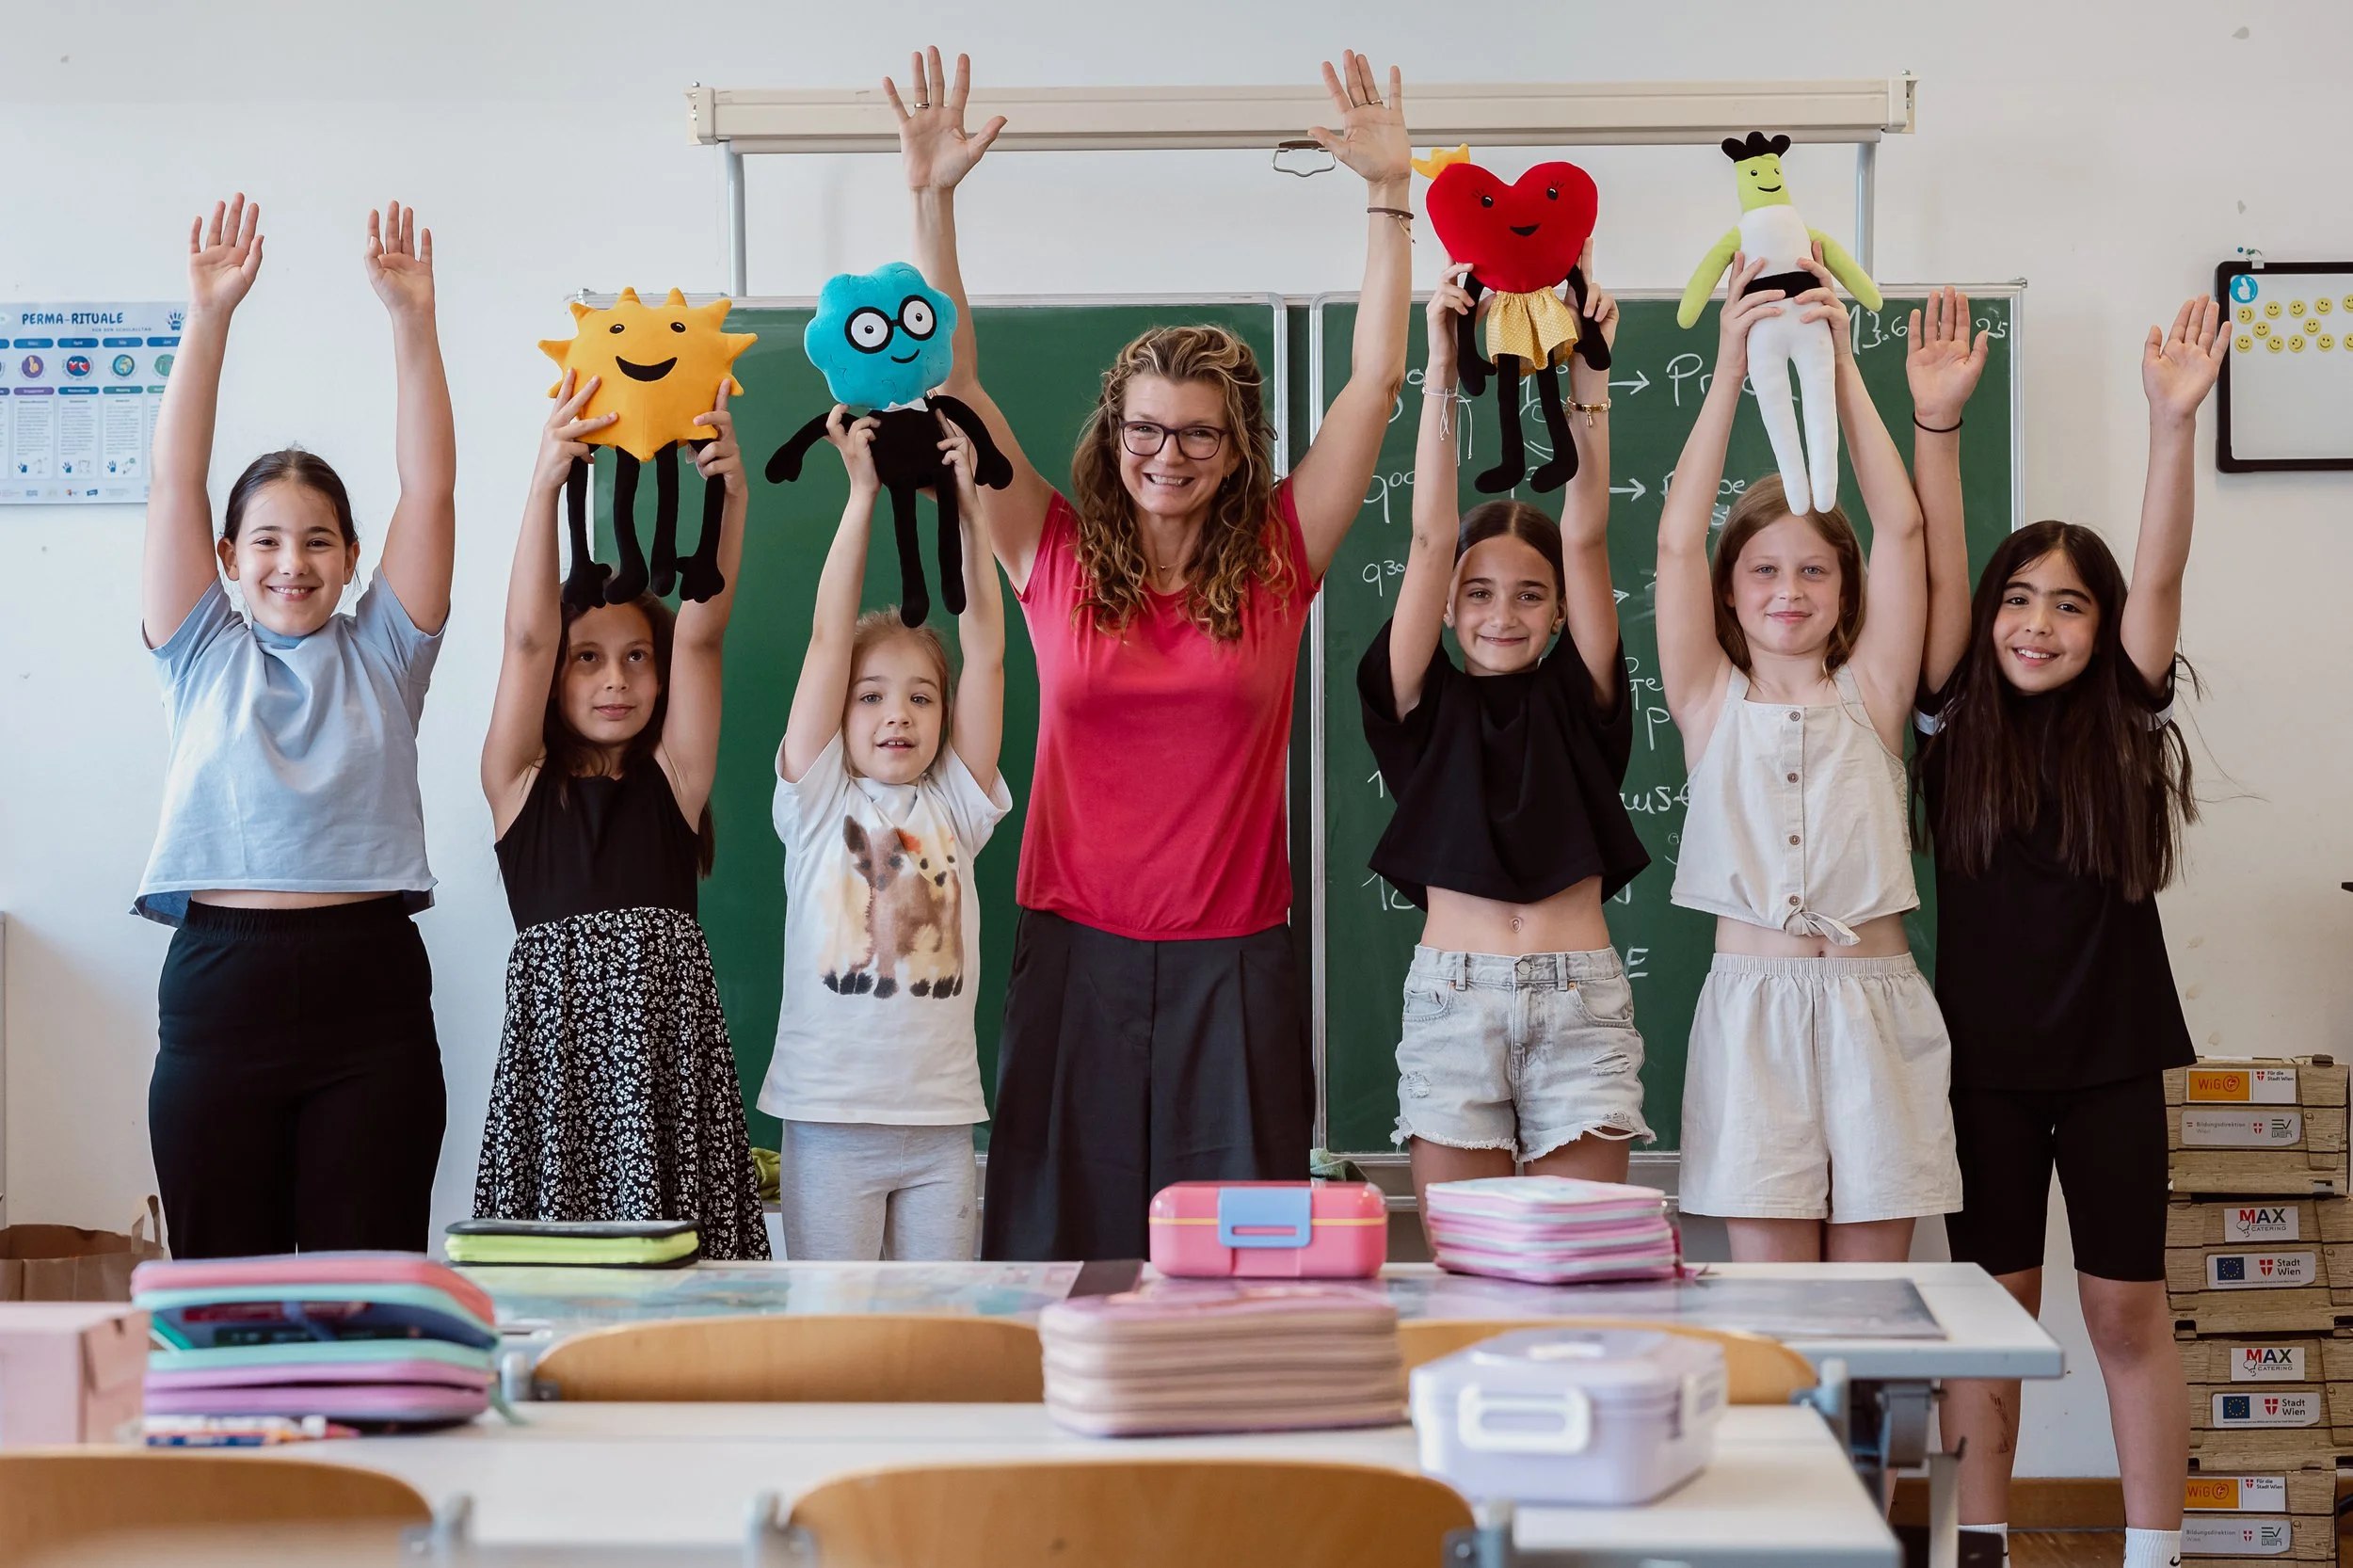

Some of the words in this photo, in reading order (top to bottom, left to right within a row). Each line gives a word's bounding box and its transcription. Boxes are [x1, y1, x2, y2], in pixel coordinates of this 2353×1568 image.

[22, 312, 123, 325] PERMA-RITUALE
[2239, 1208, 2286, 1224] MAX
[2277, 1258, 2300, 1267] Stadt
[2246, 1349, 2292, 1364] MAX
[2282, 1399, 2305, 1407] Stadt
